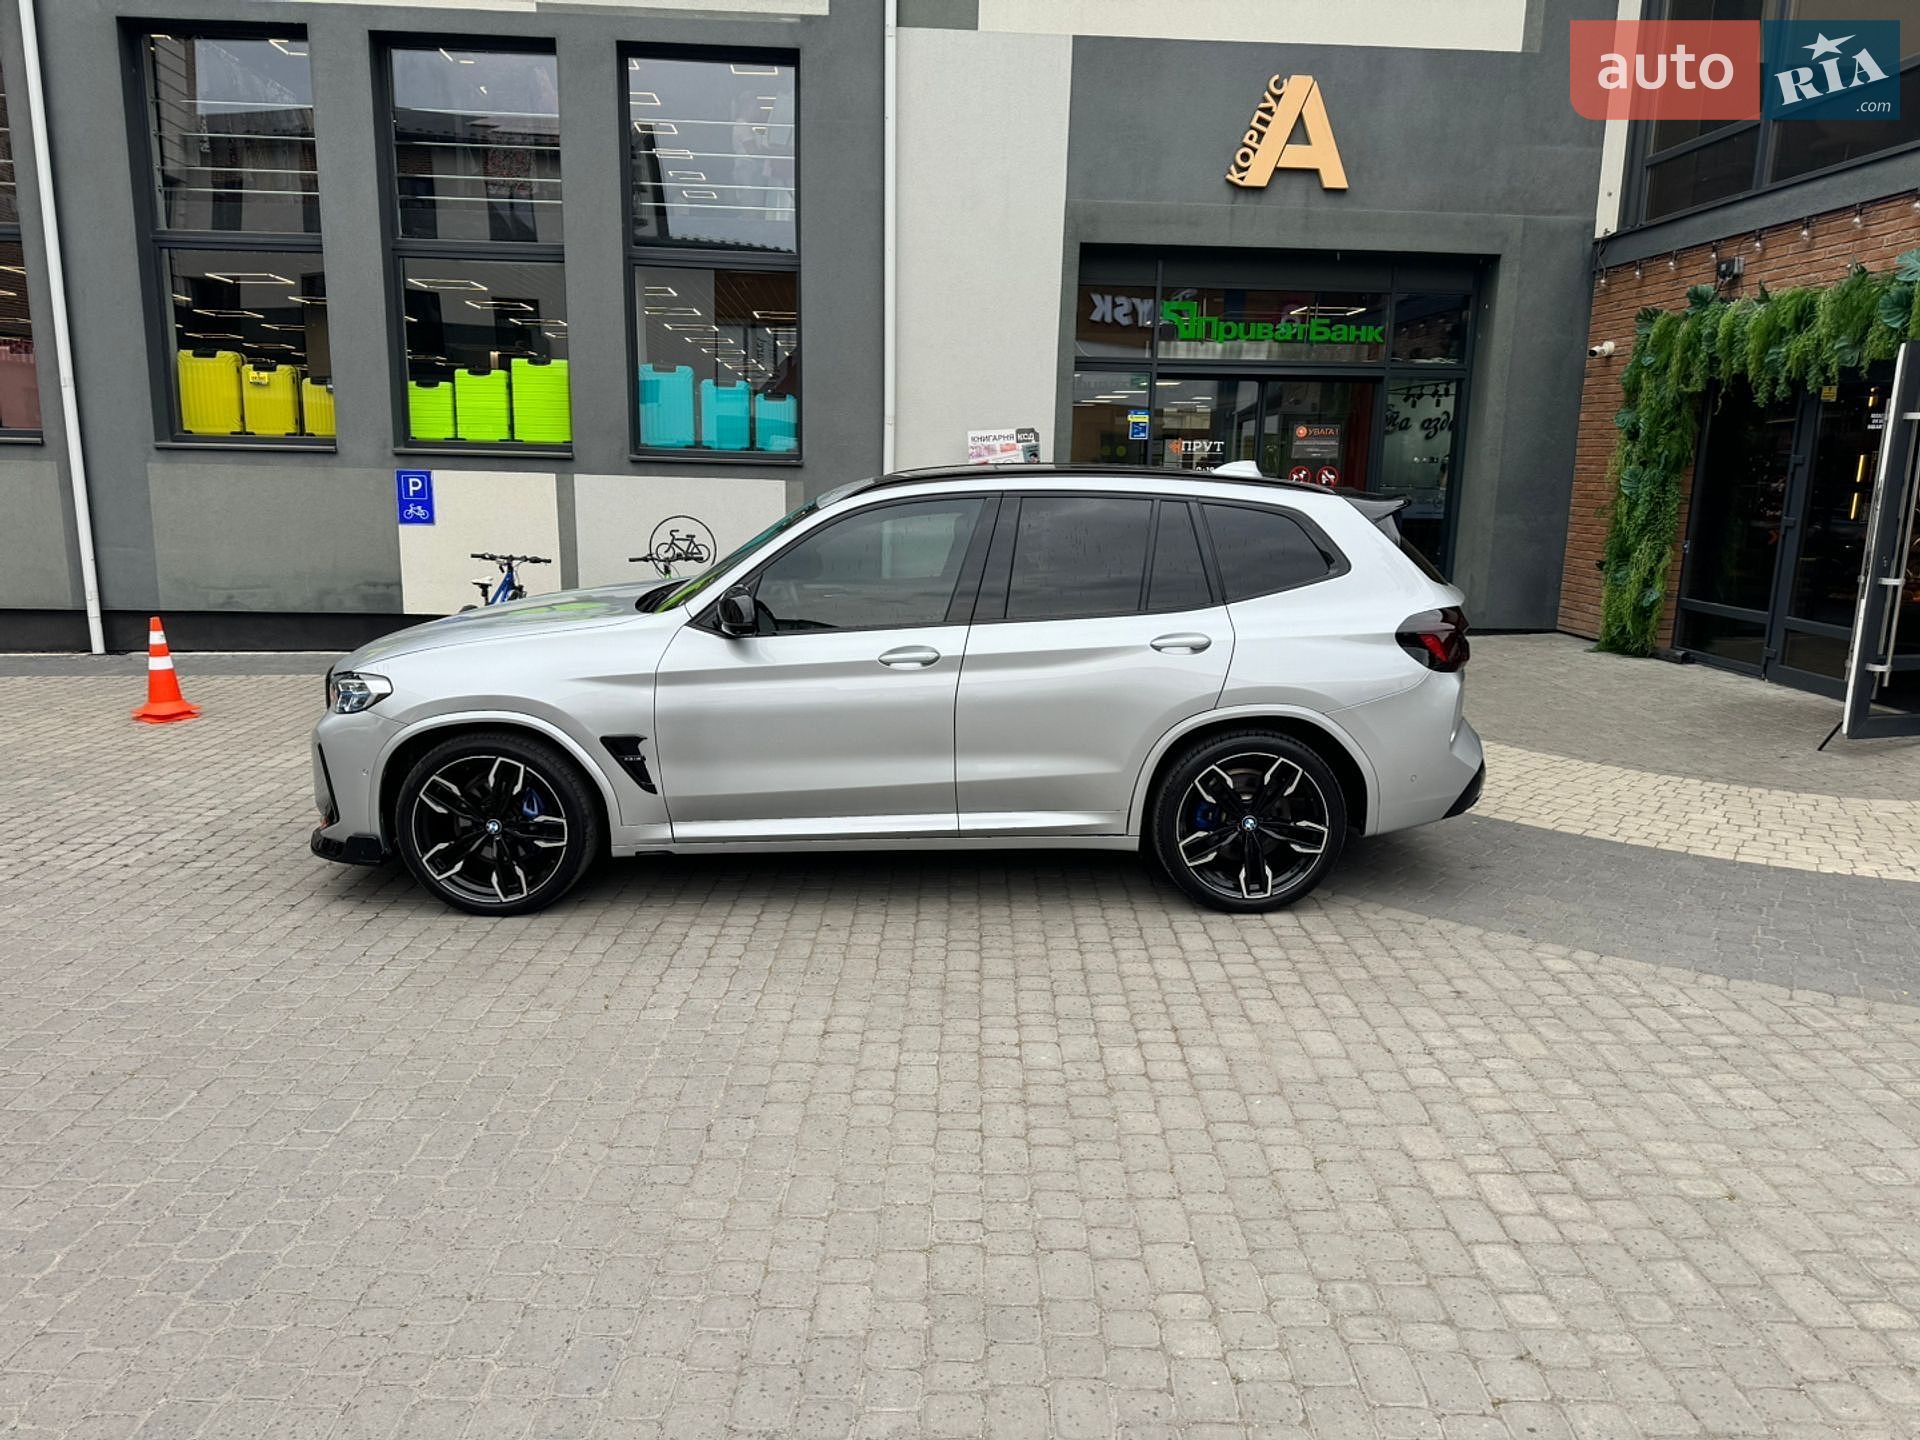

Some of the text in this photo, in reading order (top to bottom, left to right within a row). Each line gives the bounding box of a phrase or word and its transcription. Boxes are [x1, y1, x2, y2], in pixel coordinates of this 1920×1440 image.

[1225, 74, 1288, 185] КОРПУС
[1196, 317, 1385, 344] ПриватБанк
[1181, 441, 1225, 452] ПРУТ
[408, 478, 422, 496] P
